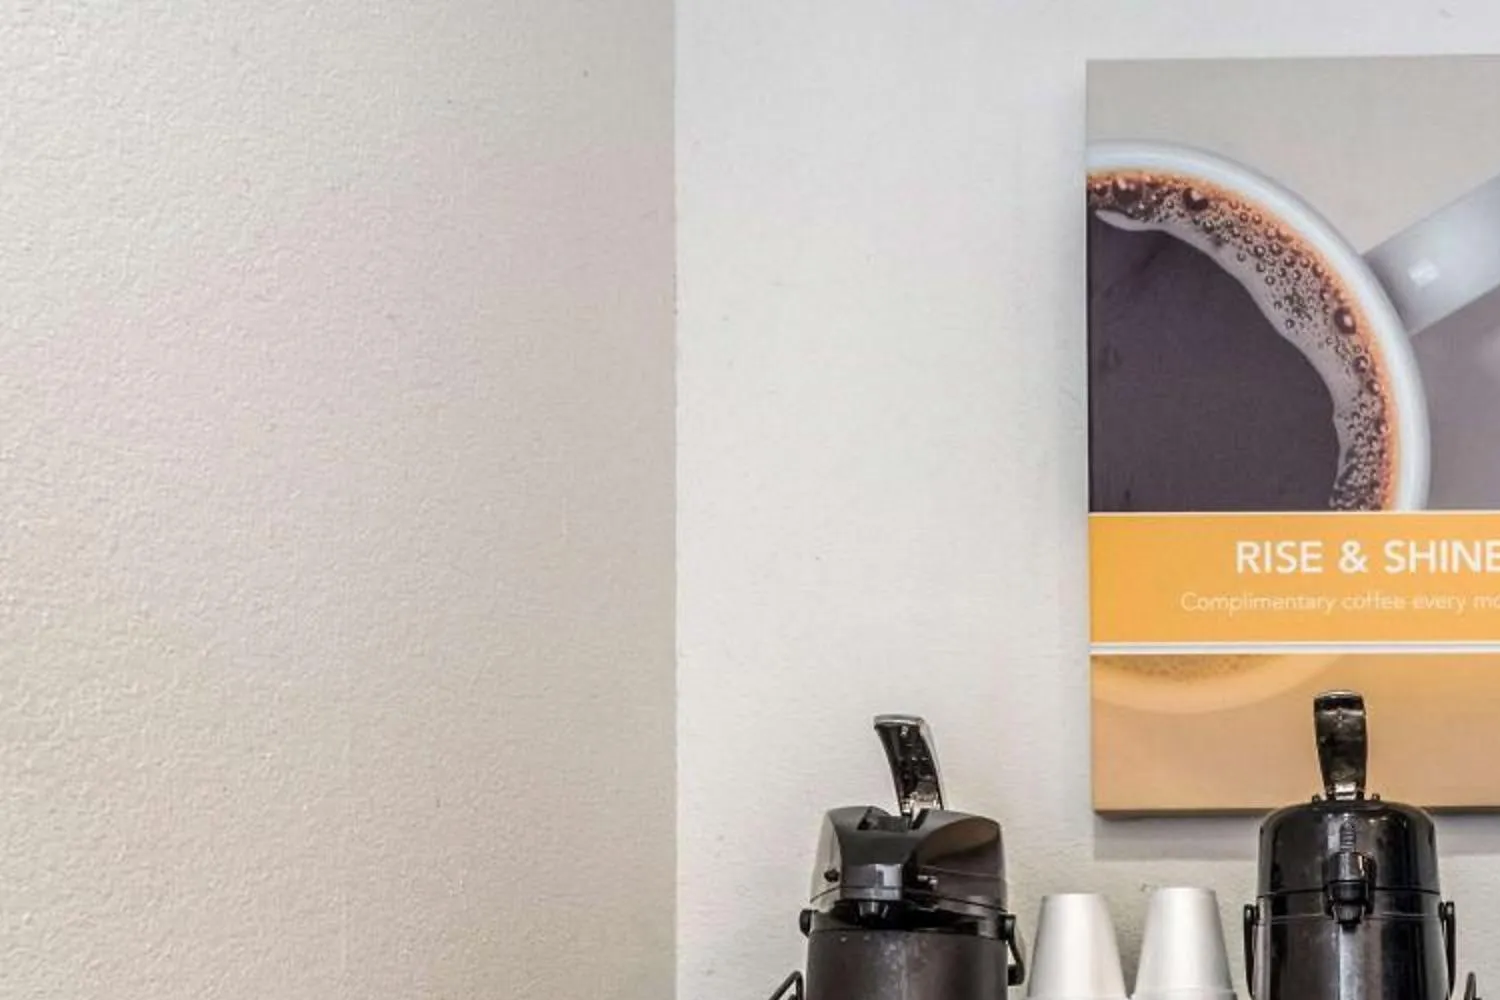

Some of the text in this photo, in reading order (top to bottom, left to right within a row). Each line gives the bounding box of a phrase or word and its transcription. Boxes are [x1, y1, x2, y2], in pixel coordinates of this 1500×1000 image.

[1236, 540, 1323, 574] RISE
[1338, 540, 1368, 574] &
[1180, 591, 1335, 616] Complimentary
[1341, 590, 1406, 610] coffee
[1413, 593, 1467, 614] every
